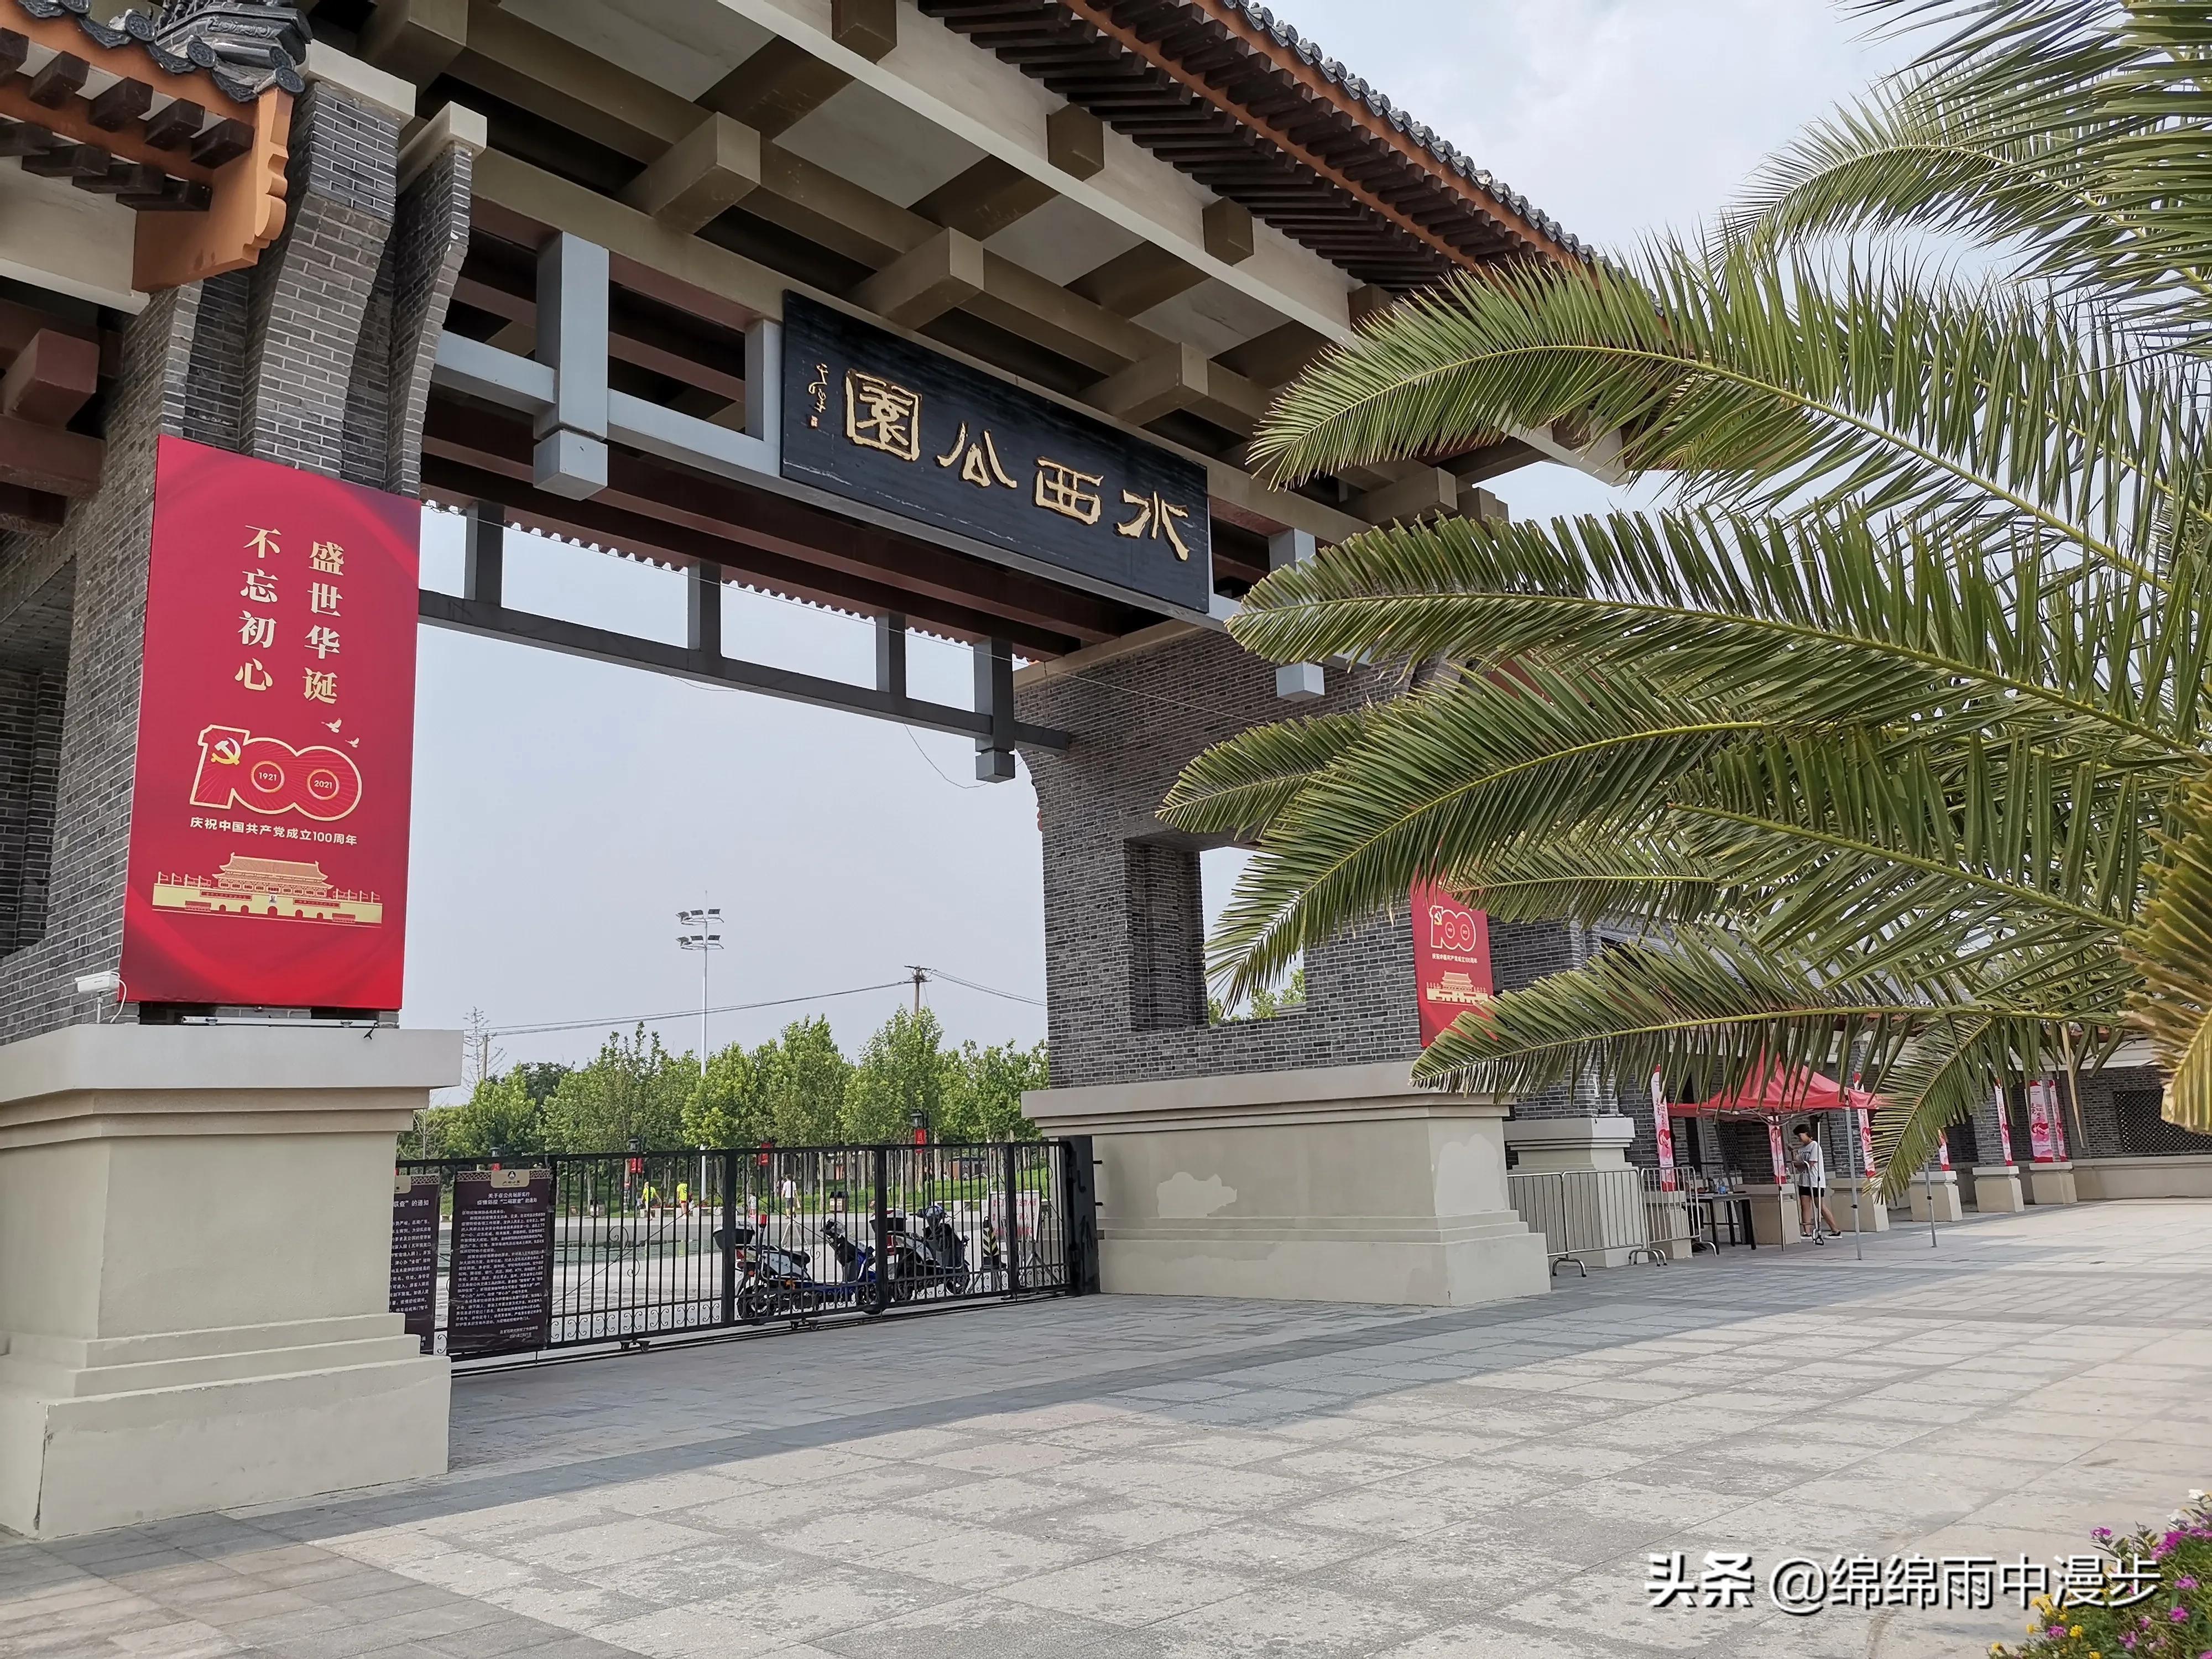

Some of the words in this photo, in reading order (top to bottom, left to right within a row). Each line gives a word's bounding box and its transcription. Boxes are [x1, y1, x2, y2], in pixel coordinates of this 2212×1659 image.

[234, 525, 282, 691] 不忘初心
[302, 541, 345, 704] 盛世华诞
[258, 772, 277, 782] 1921
[314, 780, 333, 790] 2021
[190, 816, 357, 846] 庆祝中国共产党成立100周年
